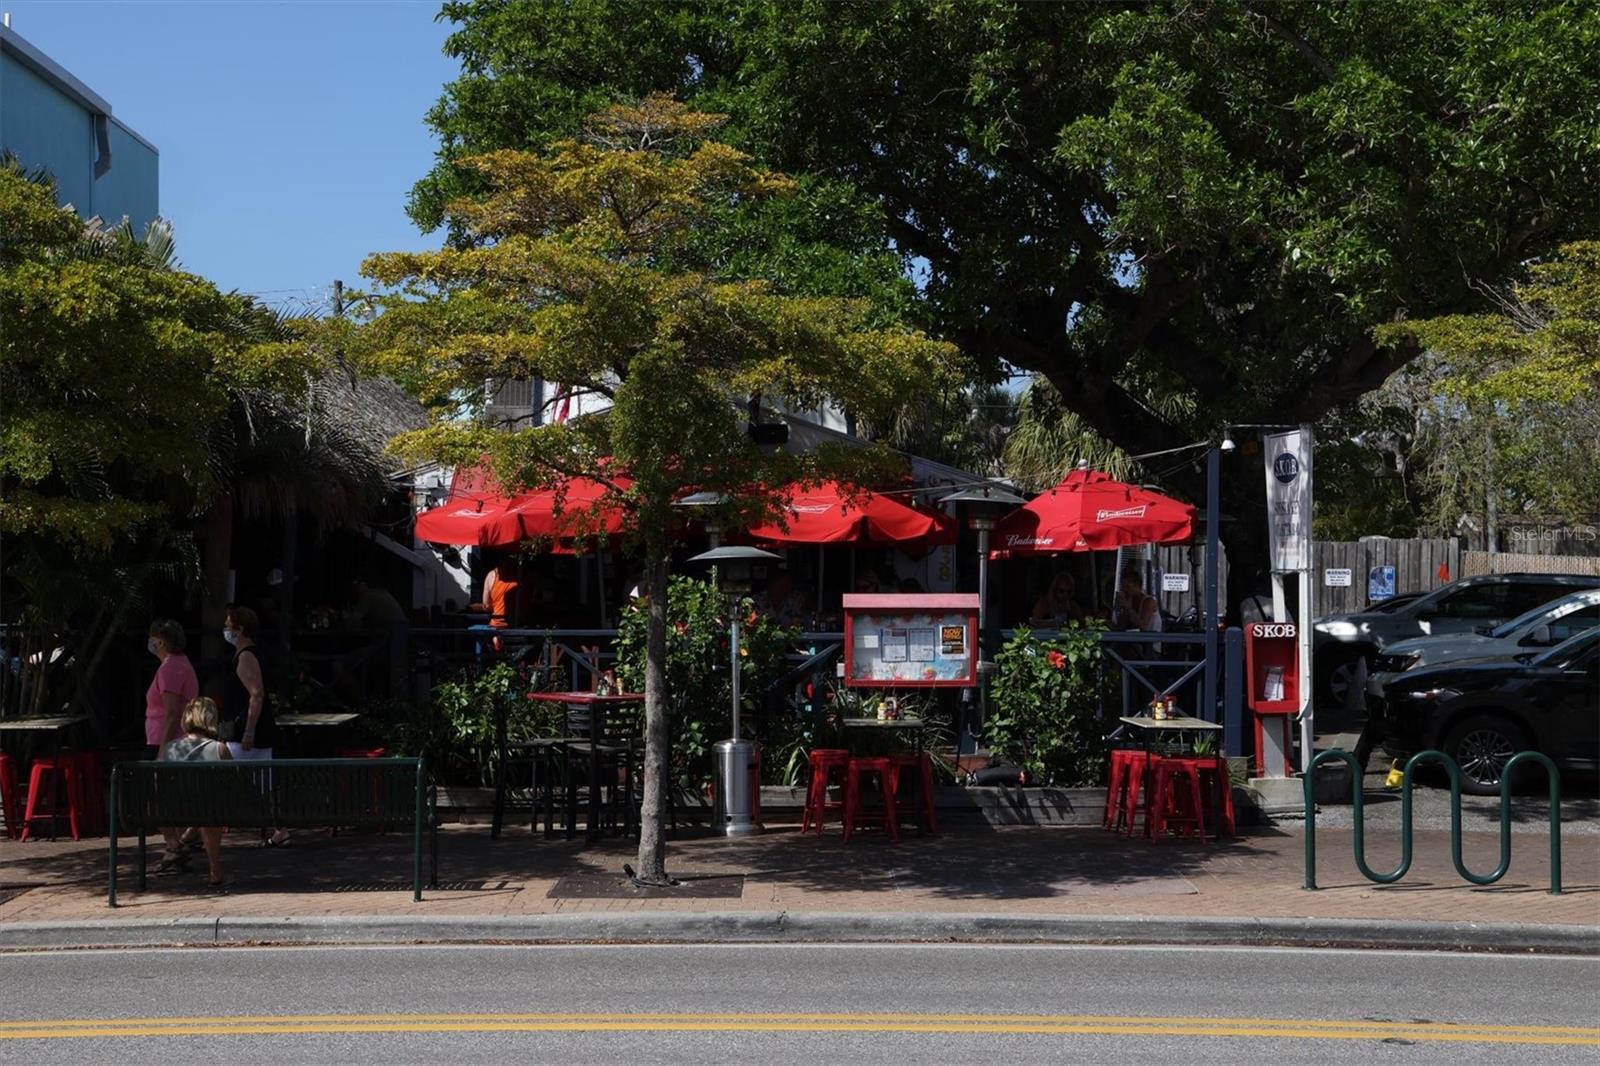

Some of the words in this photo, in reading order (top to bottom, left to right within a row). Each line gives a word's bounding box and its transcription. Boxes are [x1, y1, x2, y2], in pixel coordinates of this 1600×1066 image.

[1275, 458, 1297, 477] SKOB
[1006, 533, 1053, 546] Budweiser
[1252, 624, 1296, 638] SKOB
